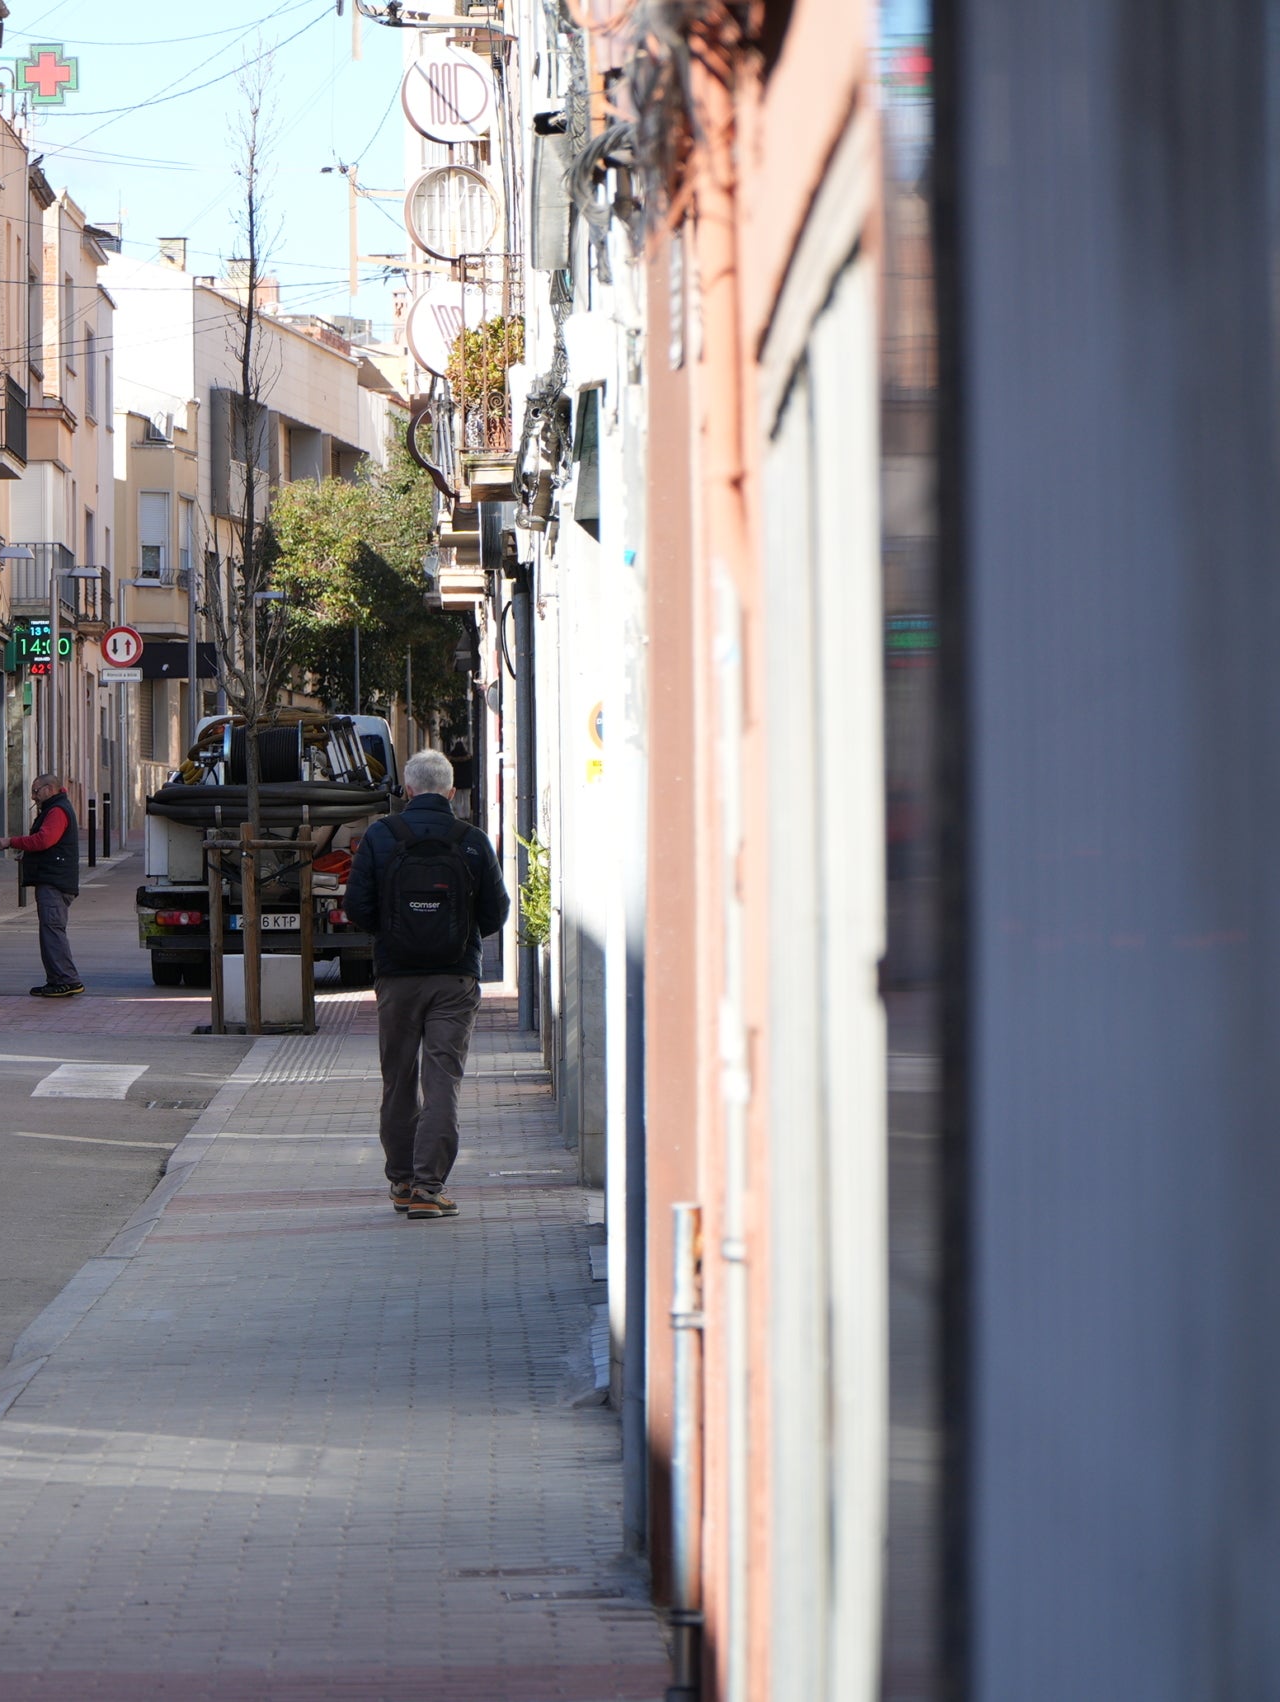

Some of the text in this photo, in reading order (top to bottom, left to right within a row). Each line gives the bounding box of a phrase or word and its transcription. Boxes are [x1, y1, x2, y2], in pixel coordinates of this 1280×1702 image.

[30, 626, 42, 636] 13
[31, 664, 45, 674] 62
[239, 916, 297, 928] 26 KTP
